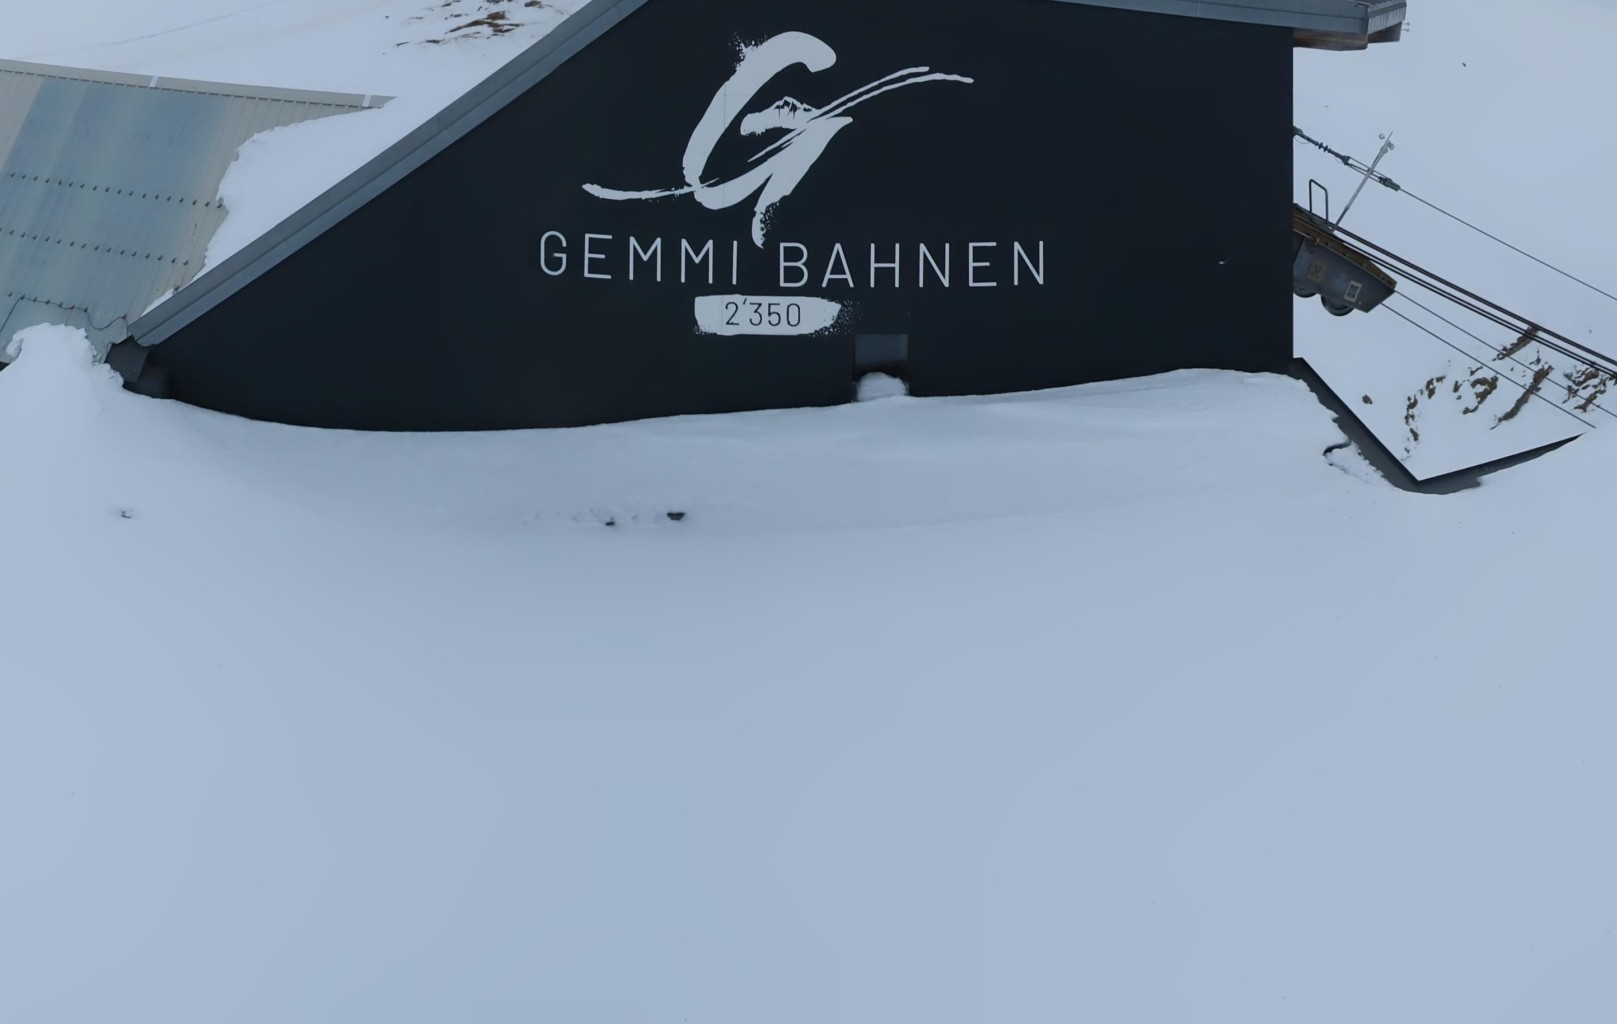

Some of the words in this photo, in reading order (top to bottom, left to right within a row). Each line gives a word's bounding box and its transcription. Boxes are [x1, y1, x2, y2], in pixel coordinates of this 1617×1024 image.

[540, 230, 739, 286] GEMMI
[779, 240, 1046, 288] BAHNEN
[725, 296, 802, 326] 2'350
